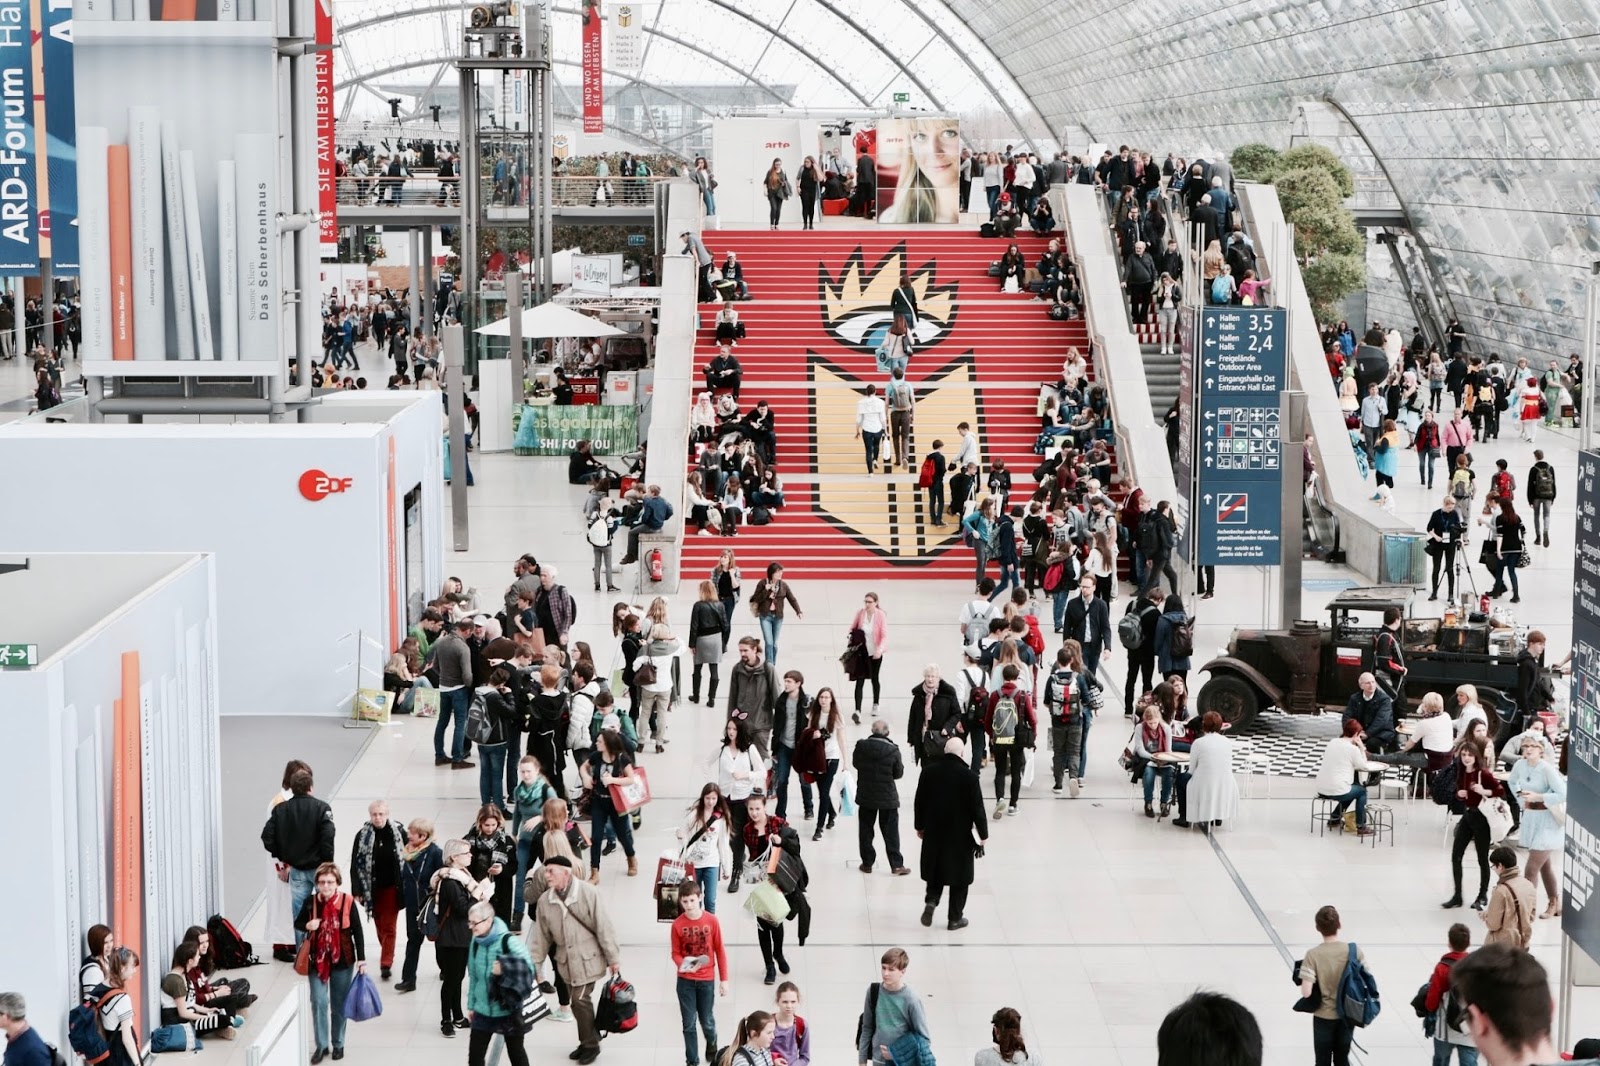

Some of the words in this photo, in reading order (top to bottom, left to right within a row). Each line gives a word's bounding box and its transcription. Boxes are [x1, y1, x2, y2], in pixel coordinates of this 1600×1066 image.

[585, 70, 592, 87] WO
[593, 81, 600, 93] AM
[316, 54, 328, 128] LIEBSTEN
[0, 68, 29, 244] ARD-Forum
[317, 136, 329, 161] AM
[318, 168, 330, 192] SIE
[257, 182, 269, 287] Scherbenhaus
[248, 288, 256, 320] Susanne
[259, 294, 269, 320] Das
[1249, 315, 1273, 332] 3,5
[1248, 335, 1273, 353] 2,4
[1219, 355, 1256, 364] Freigelände
[1218, 375, 1262, 384] Eingangshalle
[540, 439, 559, 449] SHI
[562, 439, 577, 449] FO
[995, 736, 1015, 744] NIKE
